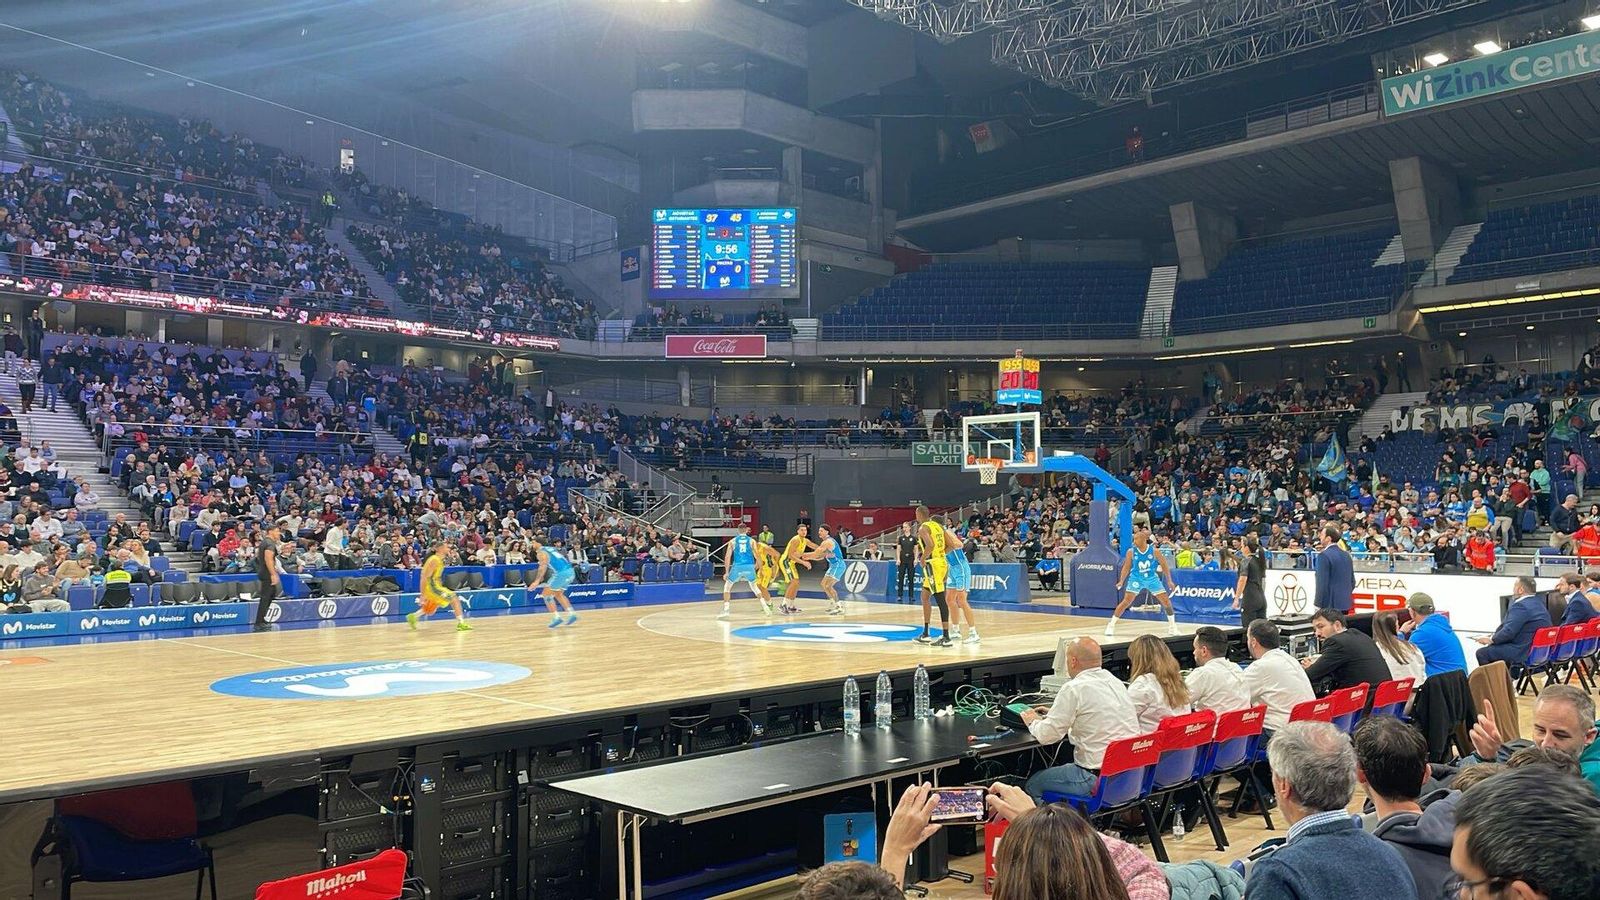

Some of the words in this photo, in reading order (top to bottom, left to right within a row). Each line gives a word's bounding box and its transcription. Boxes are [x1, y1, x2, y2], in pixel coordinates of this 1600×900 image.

[705, 213, 718, 222] 37
[730, 213, 743, 222] 45
[715, 244, 738, 254] 9:56
[916, 444, 976, 455] SALIDA
[933, 455, 959, 464] EXIT
[848, 562, 866, 593] hp
[970, 574, 996, 590] UMA
[1355, 578, 1407, 590] MERA
[321, 600, 335, 619] hp
[374, 597, 388, 615] hp
[158, 614, 186, 622] Movistar
[212, 612, 238, 620] Movistar
[25, 622, 56, 631] Movistar
[102, 618, 131, 626] Movistar
[306, 869, 367, 896] Mahou
